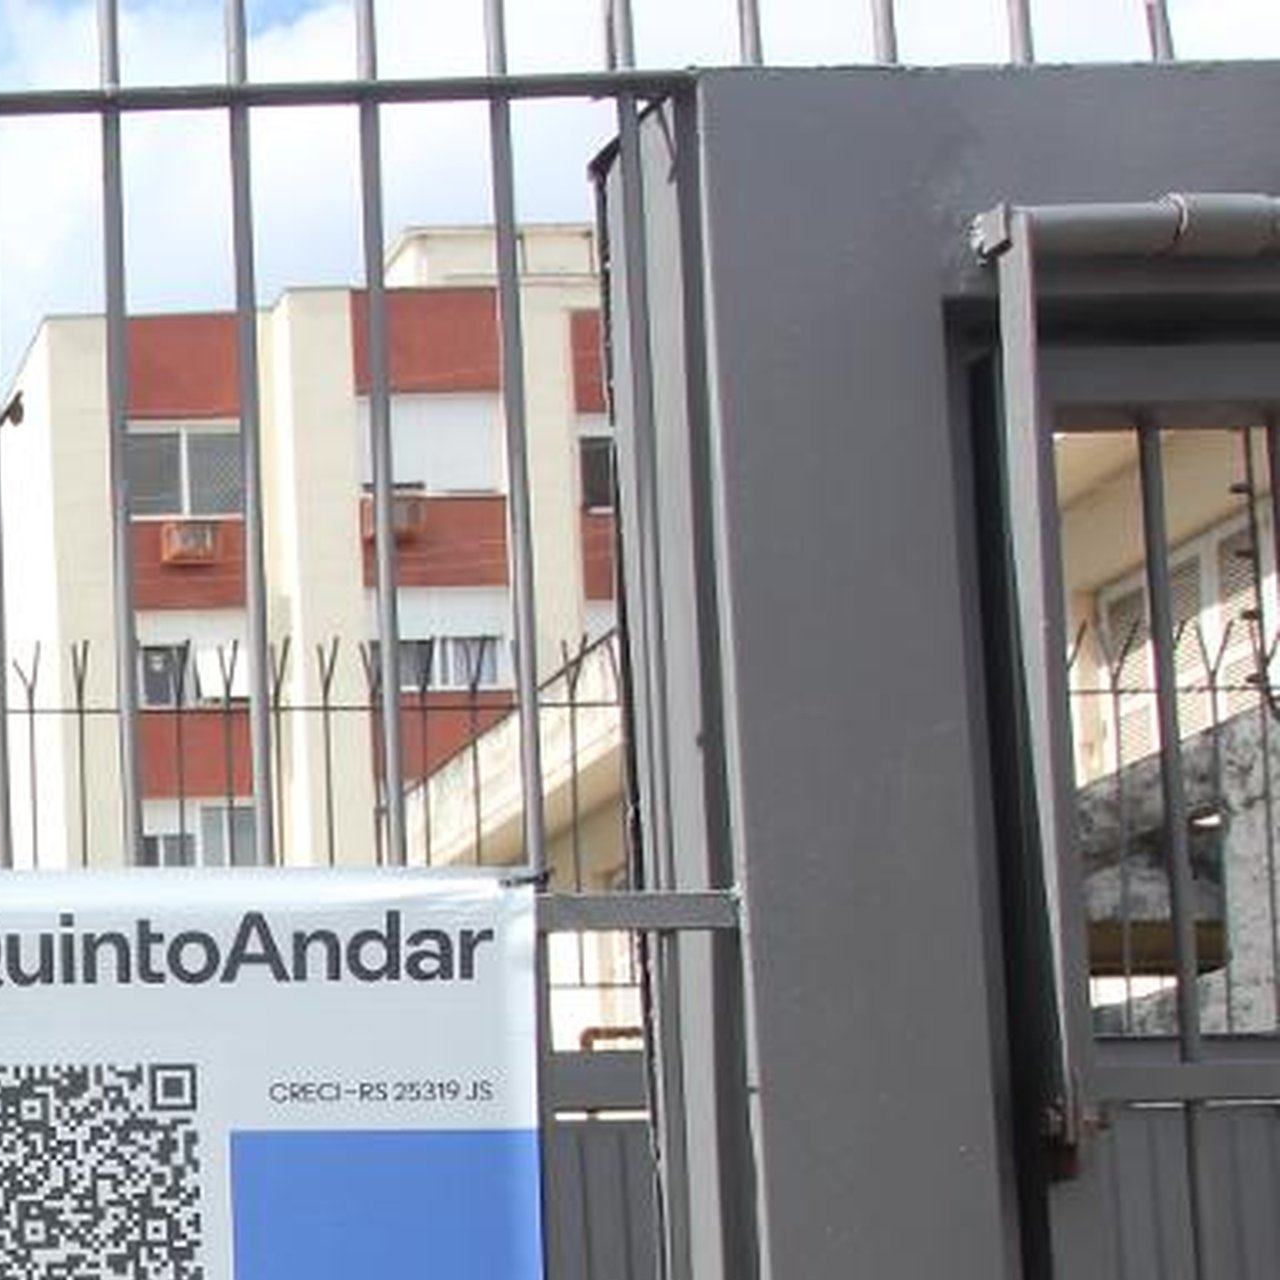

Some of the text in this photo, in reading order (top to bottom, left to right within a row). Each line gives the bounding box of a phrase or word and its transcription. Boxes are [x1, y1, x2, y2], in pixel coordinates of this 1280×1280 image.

[268, 1079, 495, 1104] CRECI-RS 25319 JS
